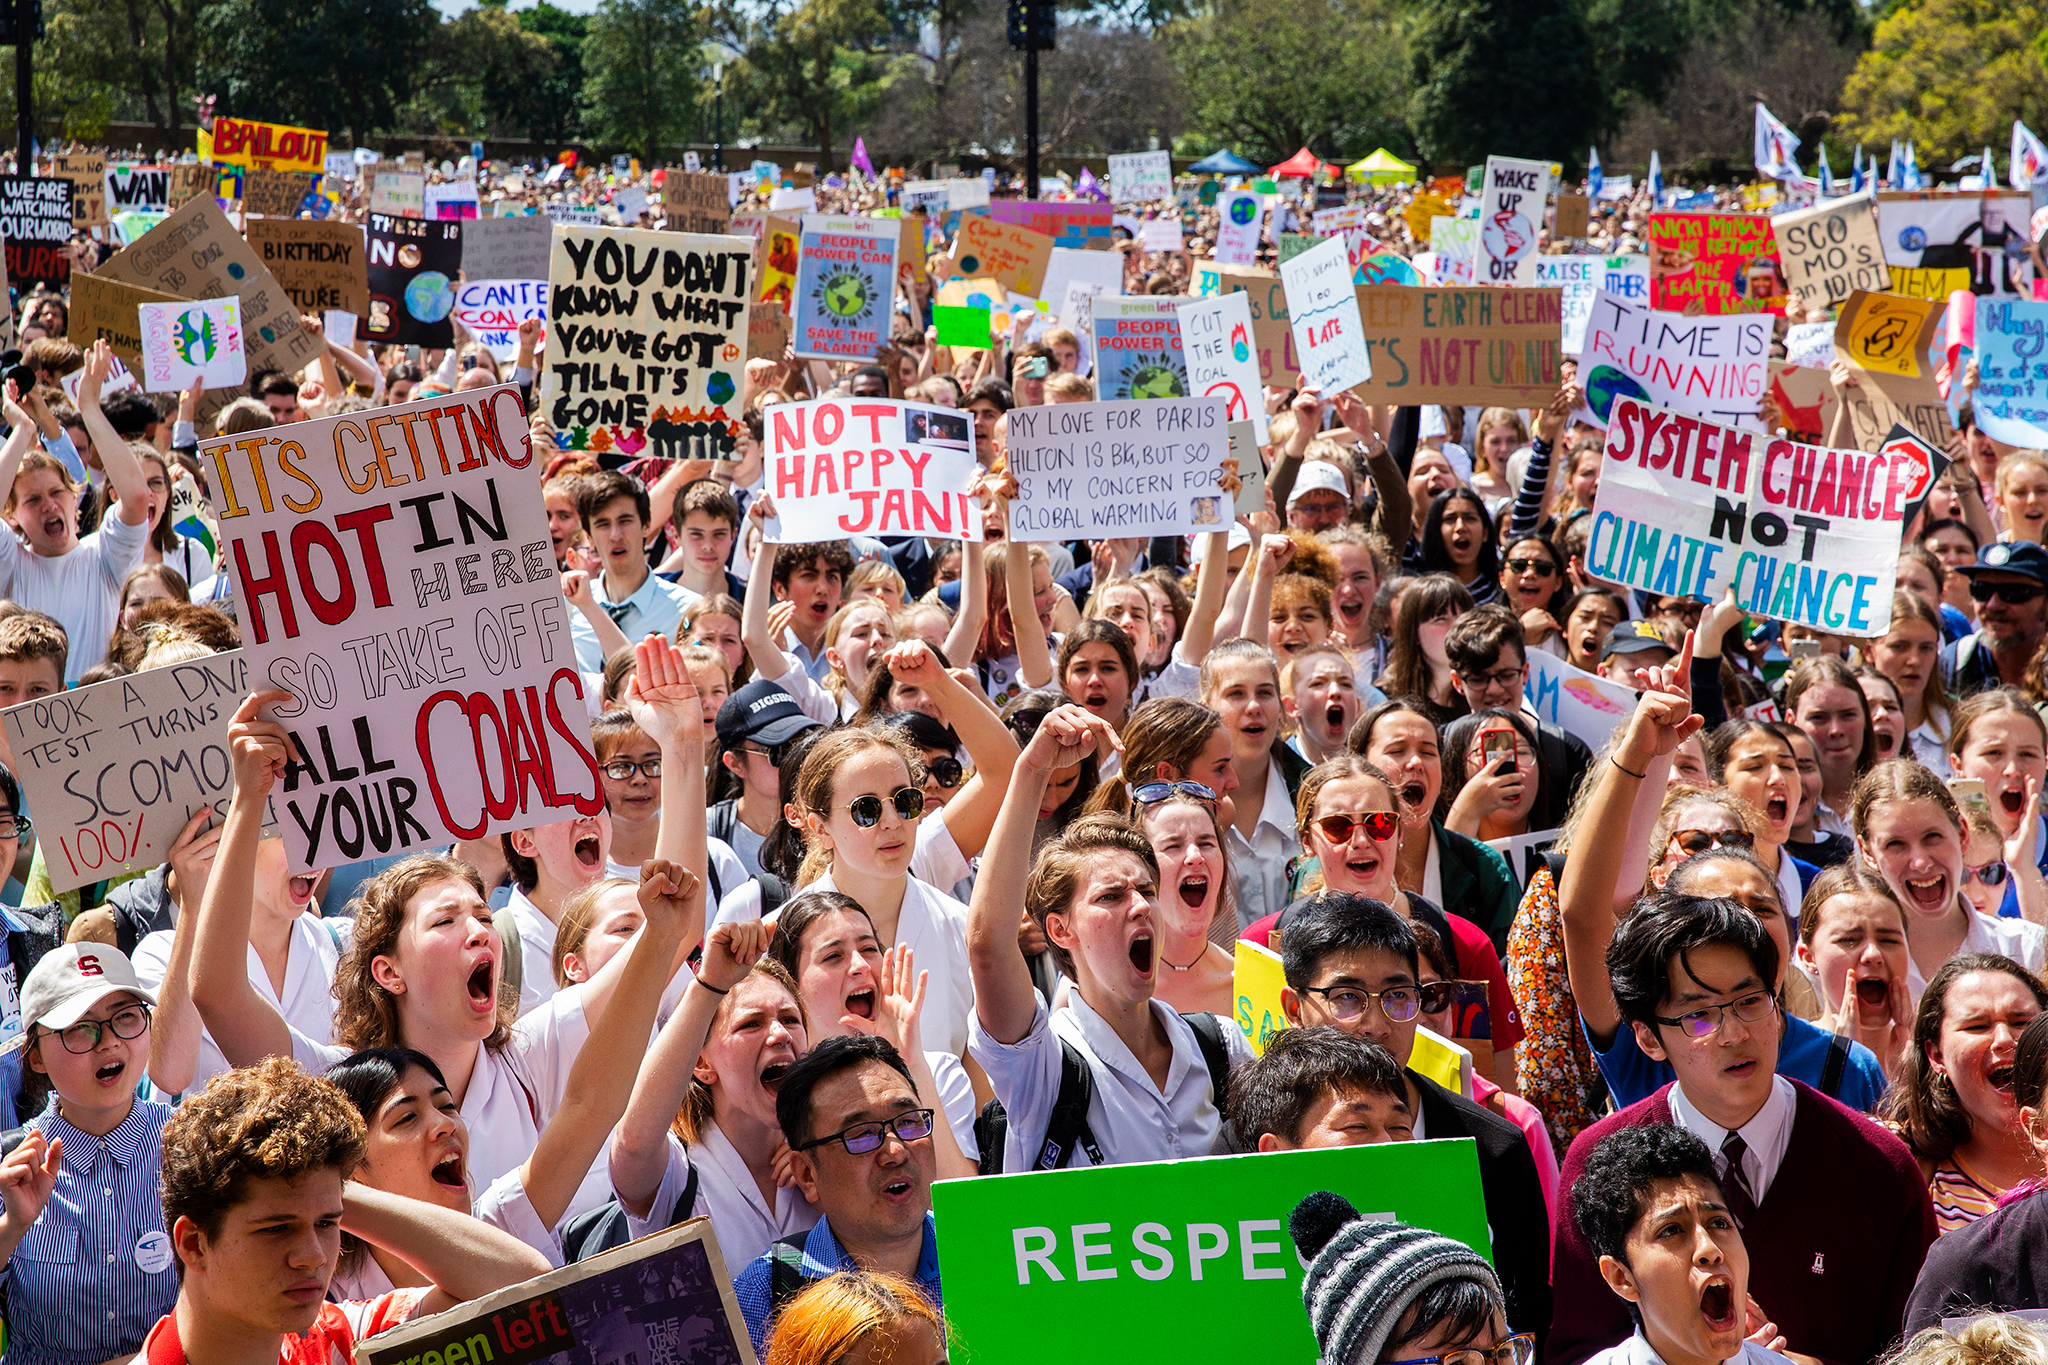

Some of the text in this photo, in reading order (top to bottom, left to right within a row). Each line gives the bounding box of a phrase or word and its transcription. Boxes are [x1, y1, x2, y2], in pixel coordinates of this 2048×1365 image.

[213, 119, 328, 167] BAILOUT
[86, 161, 103, 175] NO
[173, 165, 219, 187] FIGHT
[1112, 156, 1169, 169] PARENTS
[4, 180, 69, 202] WE ARE
[1111, 171, 1168, 188] CLIMATE
[1120, 184, 1169, 199] ACTION
[1493, 168, 1540, 192] WAKE
[0, 197, 72, 219] WATCHING
[1498, 193, 1522, 213] UP
[0, 215, 73, 243] OUR WORLD
[370, 213, 428, 237] THERE
[825, 221, 872, 232] green left
[1708, 217, 1768, 238] MINAJ
[1786, 214, 1848, 256] SCO
[130, 211, 210, 277] GREATEST
[263, 242, 353, 265] BIRTHDAY
[803, 246, 893, 265] POWER CAN
[820, 233, 878, 251] PEOPLE
[5, 244, 69, 281] BURN
[160, 266, 187, 292] TO
[191, 240, 225, 271] OUR
[295, 268, 313, 279] we
[325, 269, 358, 286] wish
[562, 236, 660, 288] YOU
[662, 250, 751, 298] DON'T
[1489, 258, 1518, 281] OR
[1536, 262, 1593, 281] RAISE
[1693, 259, 1725, 279] THE
[1669, 277, 1731, 297] EARTH
[1794, 262, 1885, 301] an IDIOT
[459, 309, 519, 326] COAL
[552, 284, 744, 330] KNOW WHAT
[1120, 301, 1176, 315] green left
[1190, 310, 1223, 336] CUT
[1362, 290, 1562, 328] EEP EARTH CLEAN
[145, 305, 171, 382] AGAIN
[164, 304, 186, 366] COOL
[806, 325, 879, 344] SAVE THE
[1098, 335, 1166, 351] POWER
[1307, 317, 1343, 349] LATE
[1603, 298, 1720, 358] TIME
[1736, 323, 1764, 358] IS
[1986, 301, 2045, 359] Why
[554, 322, 727, 369] YOU'VE GOT
[812, 339, 871, 356] PLANET
[1191, 338, 1224, 362] THE
[551, 362, 689, 396] TILL IT'S
[1194, 365, 1228, 384] COAL
[1366, 337, 1410, 388] T'S
[1419, 337, 1482, 387] NOT
[1980, 352, 2004, 380] be
[2008, 357, 2030, 380] at
[1980, 378, 2035, 398] won't
[552, 393, 650, 430] GONE
[773, 402, 898, 454] NOT
[1010, 405, 1216, 438] MY LOVE FOR PARIS
[202, 436, 324, 520] IT'S
[332, 388, 534, 496] GETTING
[1009, 442, 1075, 476] HILTON
[1086, 440, 1104, 469] IS
[1142, 443, 1181, 465] BUT
[1183, 442, 1210, 466] SO
[1606, 399, 1910, 522] SYSTEM CHANGE
[776, 448, 932, 499] HAPPY
[1047, 477, 1074, 501] MY
[1087, 473, 1173, 500] CONCERN
[1183, 468, 1224, 489] FOR
[838, 488, 971, 539] JAN!
[1014, 500, 1178, 532] GLOBAL WARMING
[1709, 493, 1831, 562] NOT
[231, 477, 509, 645] HOT IN
[410, 540, 554, 609] HERE
[1587, 509, 1878, 631] CLIMATE CHANGE
[267, 596, 560, 719] SO TAKE OFF
[4, 692, 94, 738] TOOK
[122, 680, 147, 713] A
[22, 702, 219, 769] TEST TURNS
[282, 715, 396, 793] ALL
[286, 667, 606, 867] YOUR COALS
[63, 744, 231, 827] SCOMO
[59, 812, 152, 877] 100%
[76, 954, 105, 978] S
[491, 1299, 569, 1355] left
[644, 1316, 680, 1336] THE
